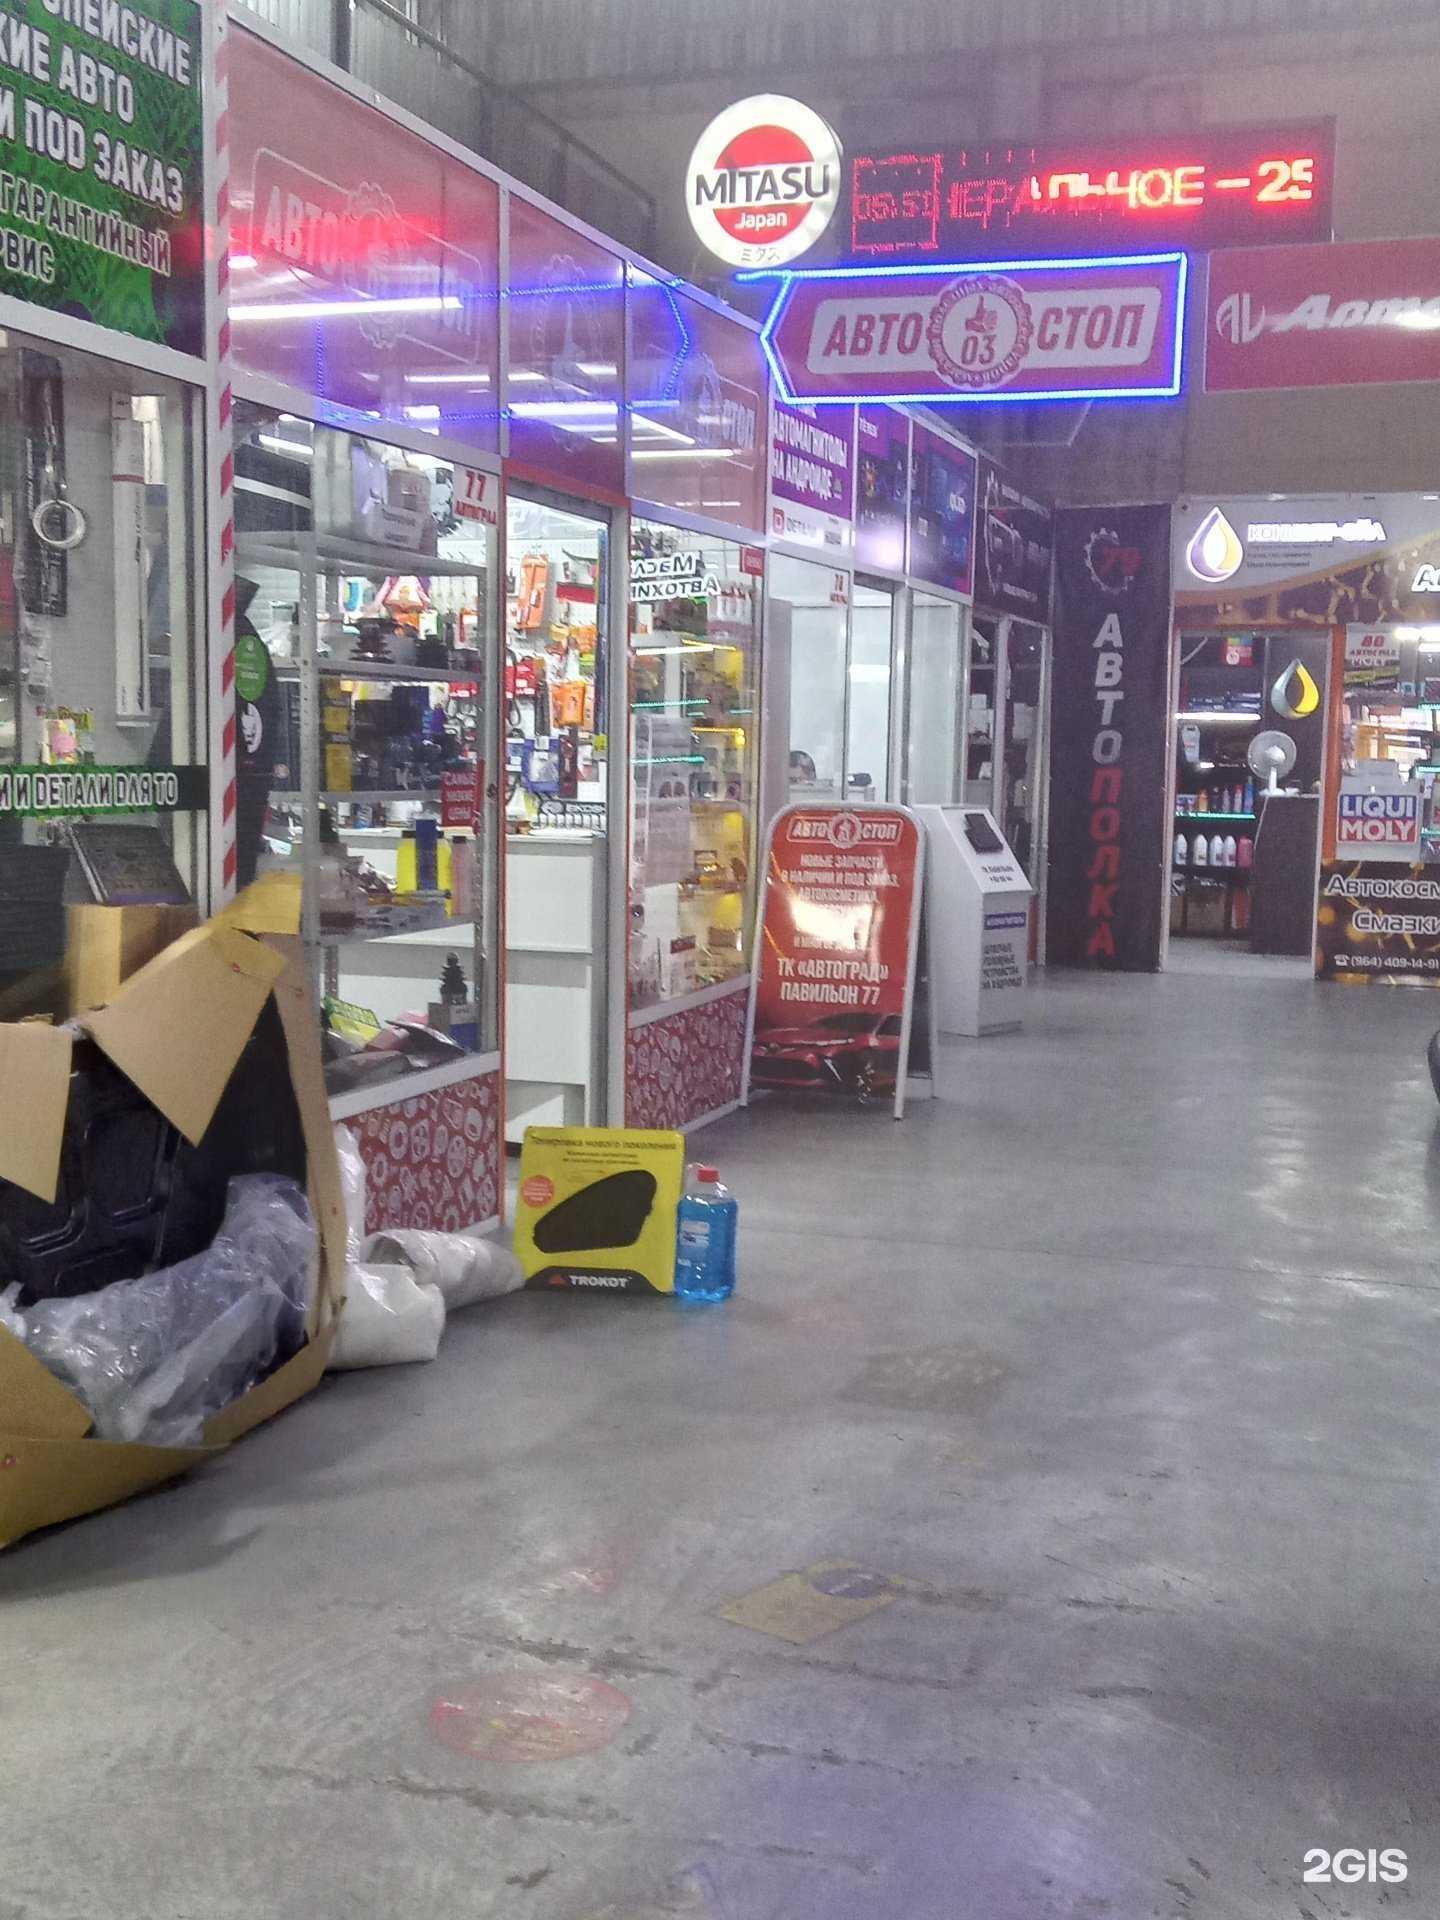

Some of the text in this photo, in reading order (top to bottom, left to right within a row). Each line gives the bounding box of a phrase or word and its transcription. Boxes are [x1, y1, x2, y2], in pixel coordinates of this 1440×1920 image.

[59, 45, 134, 123] АВТО
[93, 132, 183, 213] ЗАКАЗ
[695, 164, 830, 206] MITASU
[734, 212, 788, 232] Japan
[0, 227, 55, 284] ВИС
[822, 303, 1146, 358] АВТО СТОП
[961, 334, 997, 366] 03
[465, 470, 487, 502] 77
[153, 772, 178, 806] ТО
[1087, 612, 1124, 957] АВТОПОЛКА
[1343, 797, 1415, 817] LIQUI
[792, 821, 899, 839] АВТО СТОП
[1341, 820, 1414, 841] MOLY
[778, 958, 889, 983] ТК «АВТОГРАД»
[780, 981, 880, 1005] ПАВИЛЬОН 77
[568, 1275, 628, 1288] TROKOT
